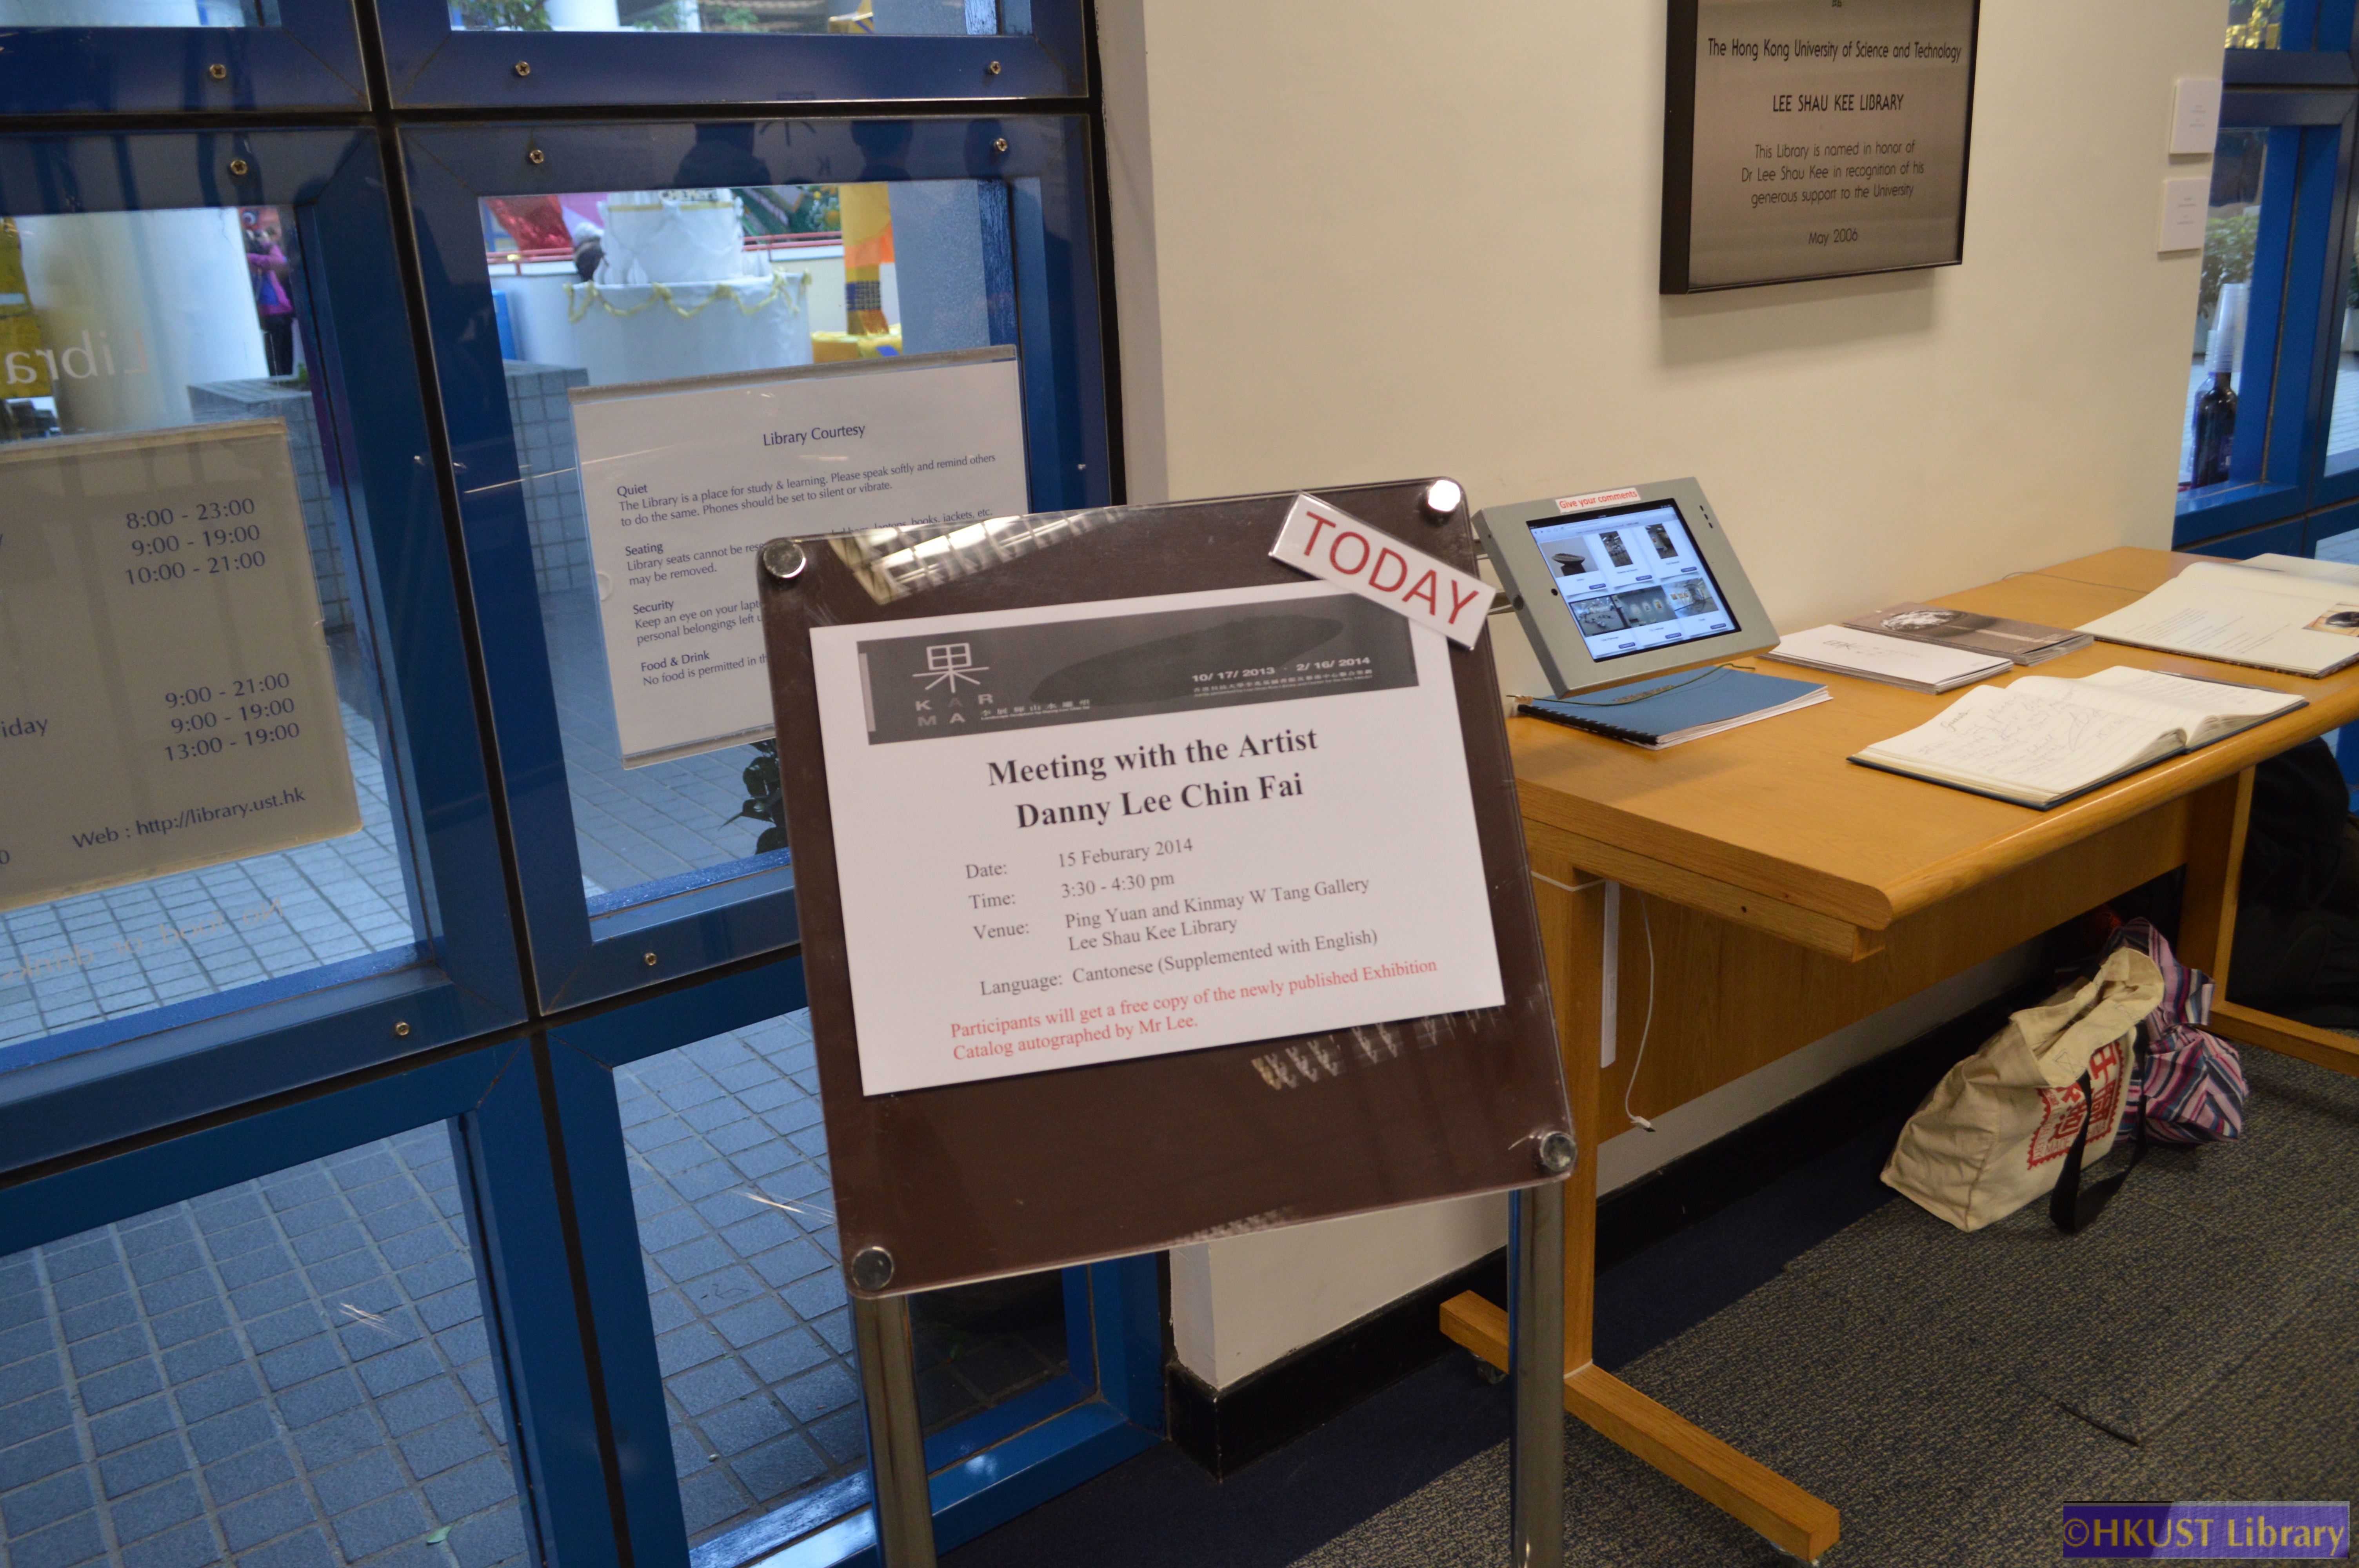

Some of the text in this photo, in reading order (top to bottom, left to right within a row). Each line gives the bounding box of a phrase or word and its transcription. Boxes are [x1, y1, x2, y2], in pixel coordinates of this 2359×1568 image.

[1708, 37, 1961, 63] The Hong Kong University of Science and Technology
[1773, 94, 1904, 112] LEE SHAU KEE LIBRARY
[1755, 139, 1916, 160] This Library is named in honor of
[1741, 161, 1924, 183] Dr Lee Shau Kee in recognition of his
[1751, 184, 1914, 209] generous support to the University
[1808, 228, 1859, 247] May 2006
[763, 425, 865, 446] Library Courtesy
[616, 484, 648, 498] Quiet
[618, 500, 639, 511] The
[642, 497, 678, 508] Library
[681, 493, 689, 503] is
[701, 489, 728, 503] place
[731, 486, 744, 496] for
[747, 481, 773, 494] study
[776, 480, 784, 490] &
[787, 477, 828, 488] learning.
[831, 472, 861, 483] Please
[863, 466, 889, 481] speak
[891, 463, 914, 475] softly
[917, 459, 934, 471] and
[936, 456, 968, 468] remind
[969, 454, 996, 465] others
[126, 508, 174, 529] 8:00
[196, 498, 255, 521] 23:00
[1559, 491, 1637, 509] Give your comments
[131, 535, 180, 556] 9:00
[203, 524, 260, 547] 19:00
[625, 543, 663, 556] Seating
[125, 562, 185, 585] 10:00
[207, 551, 265, 574] 21:00
[1304, 510, 1479, 624] TODAY
[632, 600, 674, 615] Security
[641, 650, 710, 672] Food & Drink
[912, 642, 990, 693] 果
[165, 686, 212, 708] 9:00
[233, 673, 289, 697] 21:00
[171, 712, 217, 733] 9:00
[239, 698, 294, 721] 19:00
[165, 737, 222, 761] 13:00
[244, 722, 300, 746] 19:00
[988, 729, 1317, 786] Meeting with the Artist
[1017, 772, 1303, 828] Danny Lee Chin Fai
[72, 787, 305, 848] Web http://library.ust.hk
[965, 838, 1193, 879] Date: 15 Feburary 2014
[968, 893, 1016, 909] Time:
[1061, 880, 1096, 898] 3:30
[1111, 874, 1146, 891] 4:30
[1150, 874, 1175, 891] pm
[973, 878, 1369, 939] Venue: Ping Yuan and Kinmay W Tang Gallery
[1068, 920, 1237, 951] Lee Shau Kee Library
[980, 930, 1378, 996] Language: Cantonese (Supplemented with English)
[951, 960, 1437, 1038] Participants will get a free copy of the newly published Exhibition
[953, 1016, 1198, 1060] Catalog autographed by Mr Lee.
